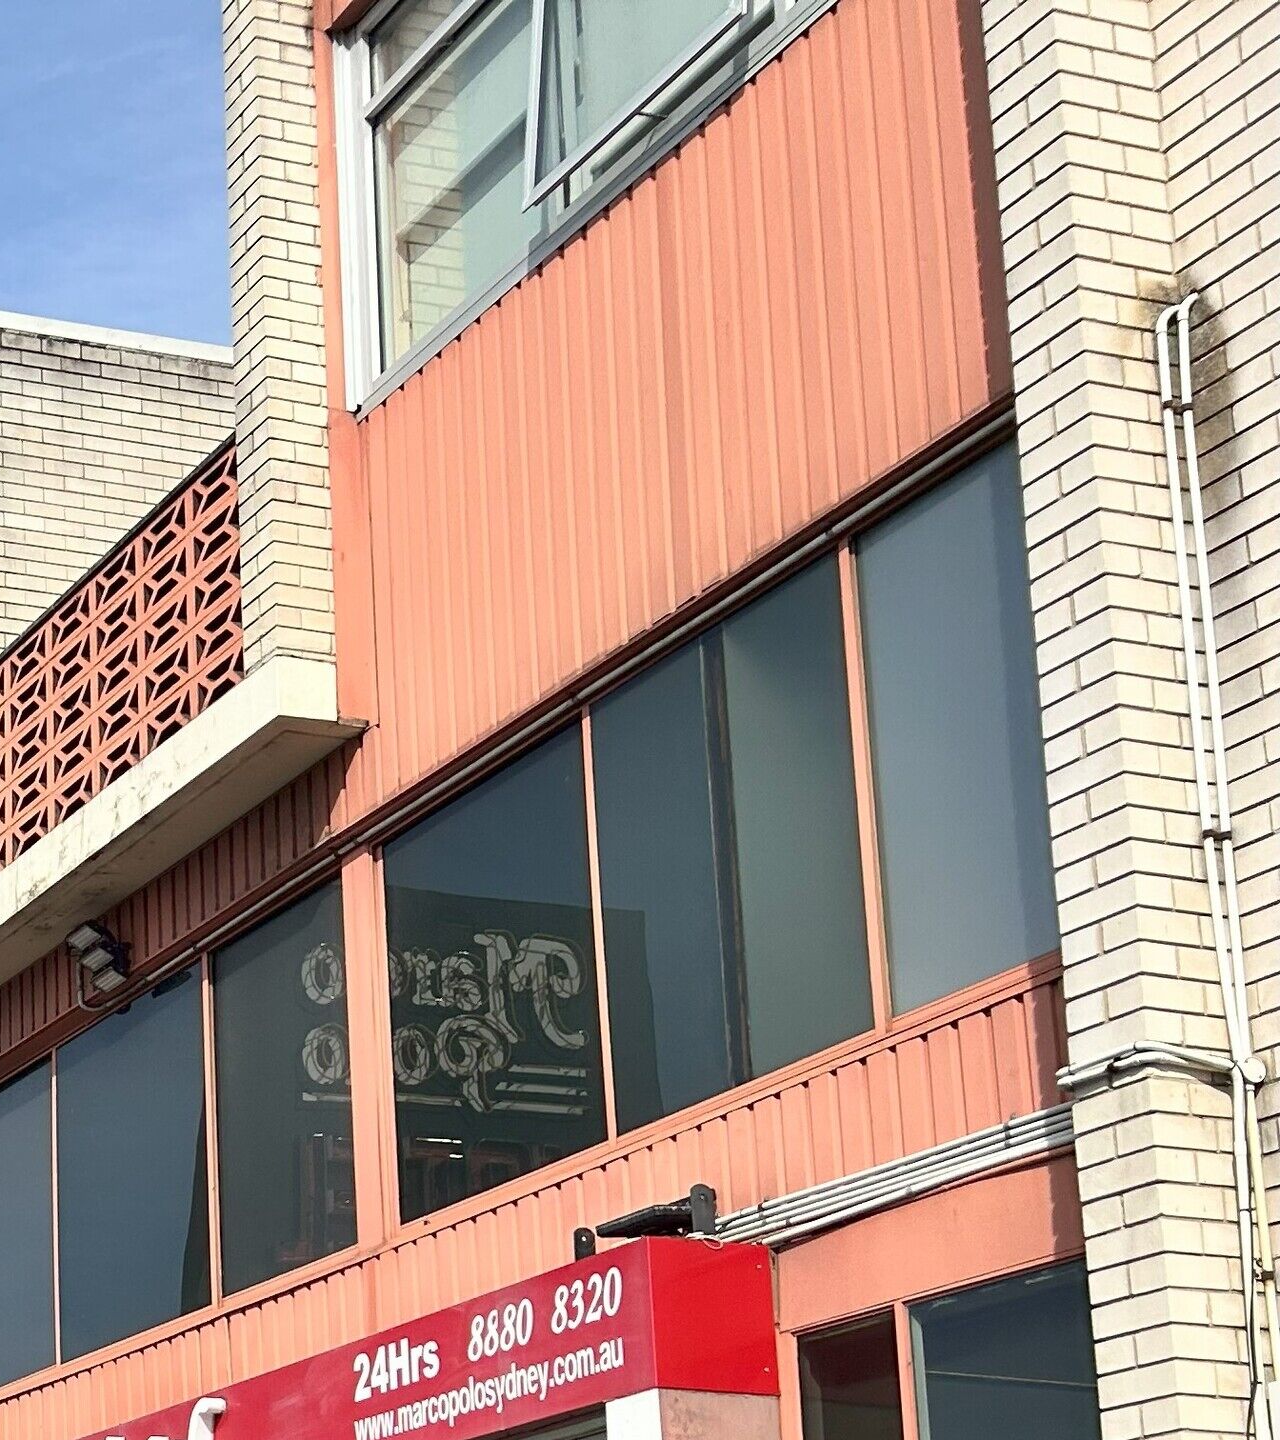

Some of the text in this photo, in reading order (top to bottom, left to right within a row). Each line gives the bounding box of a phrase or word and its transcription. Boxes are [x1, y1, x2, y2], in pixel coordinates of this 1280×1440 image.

[353, 1267, 622, 1402] 24Hrs 8880 8320
